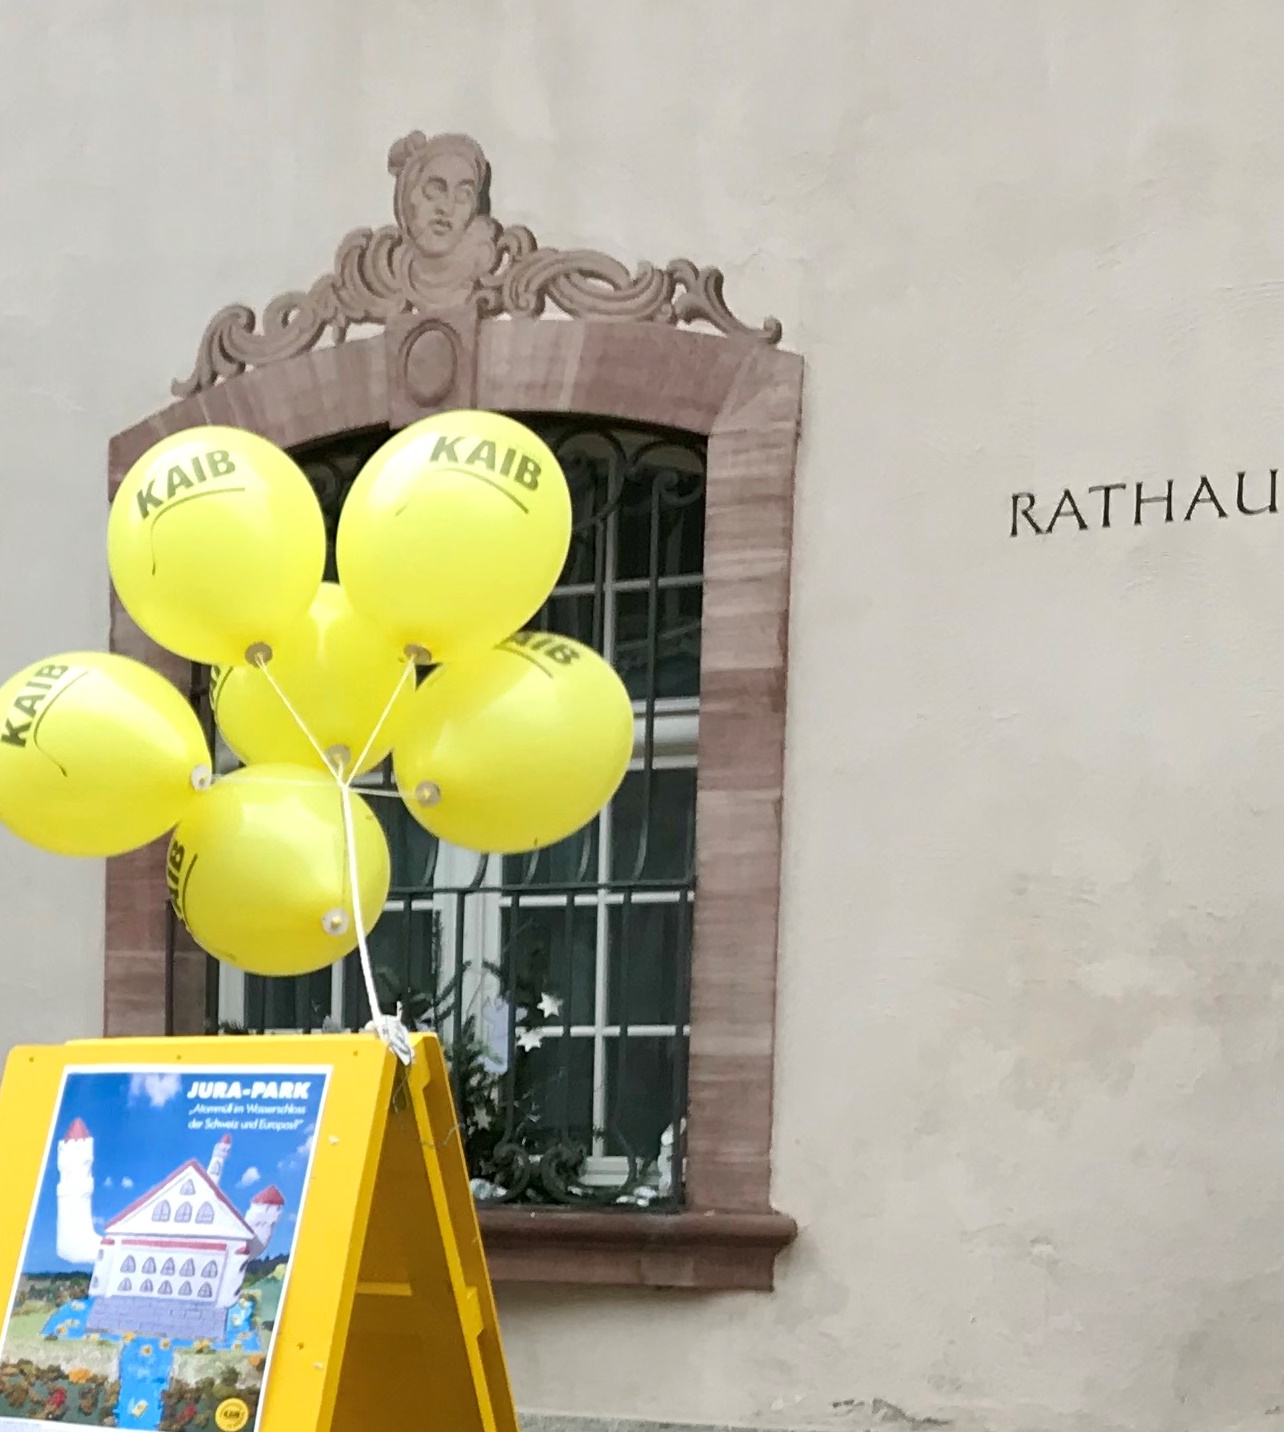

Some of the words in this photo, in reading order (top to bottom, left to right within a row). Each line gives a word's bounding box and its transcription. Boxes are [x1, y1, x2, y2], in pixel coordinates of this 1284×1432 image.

[136, 450, 236, 519] KAIB
[430, 436, 542, 491] KAIB
[0, 664, 69, 748] KAIB
[187, 1081, 312, 1099] JURA-PARK
[188, 1118, 203, 1129] der
[205, 1117, 239, 1130] Schweiz
[240, 1117, 258, 1130] und
